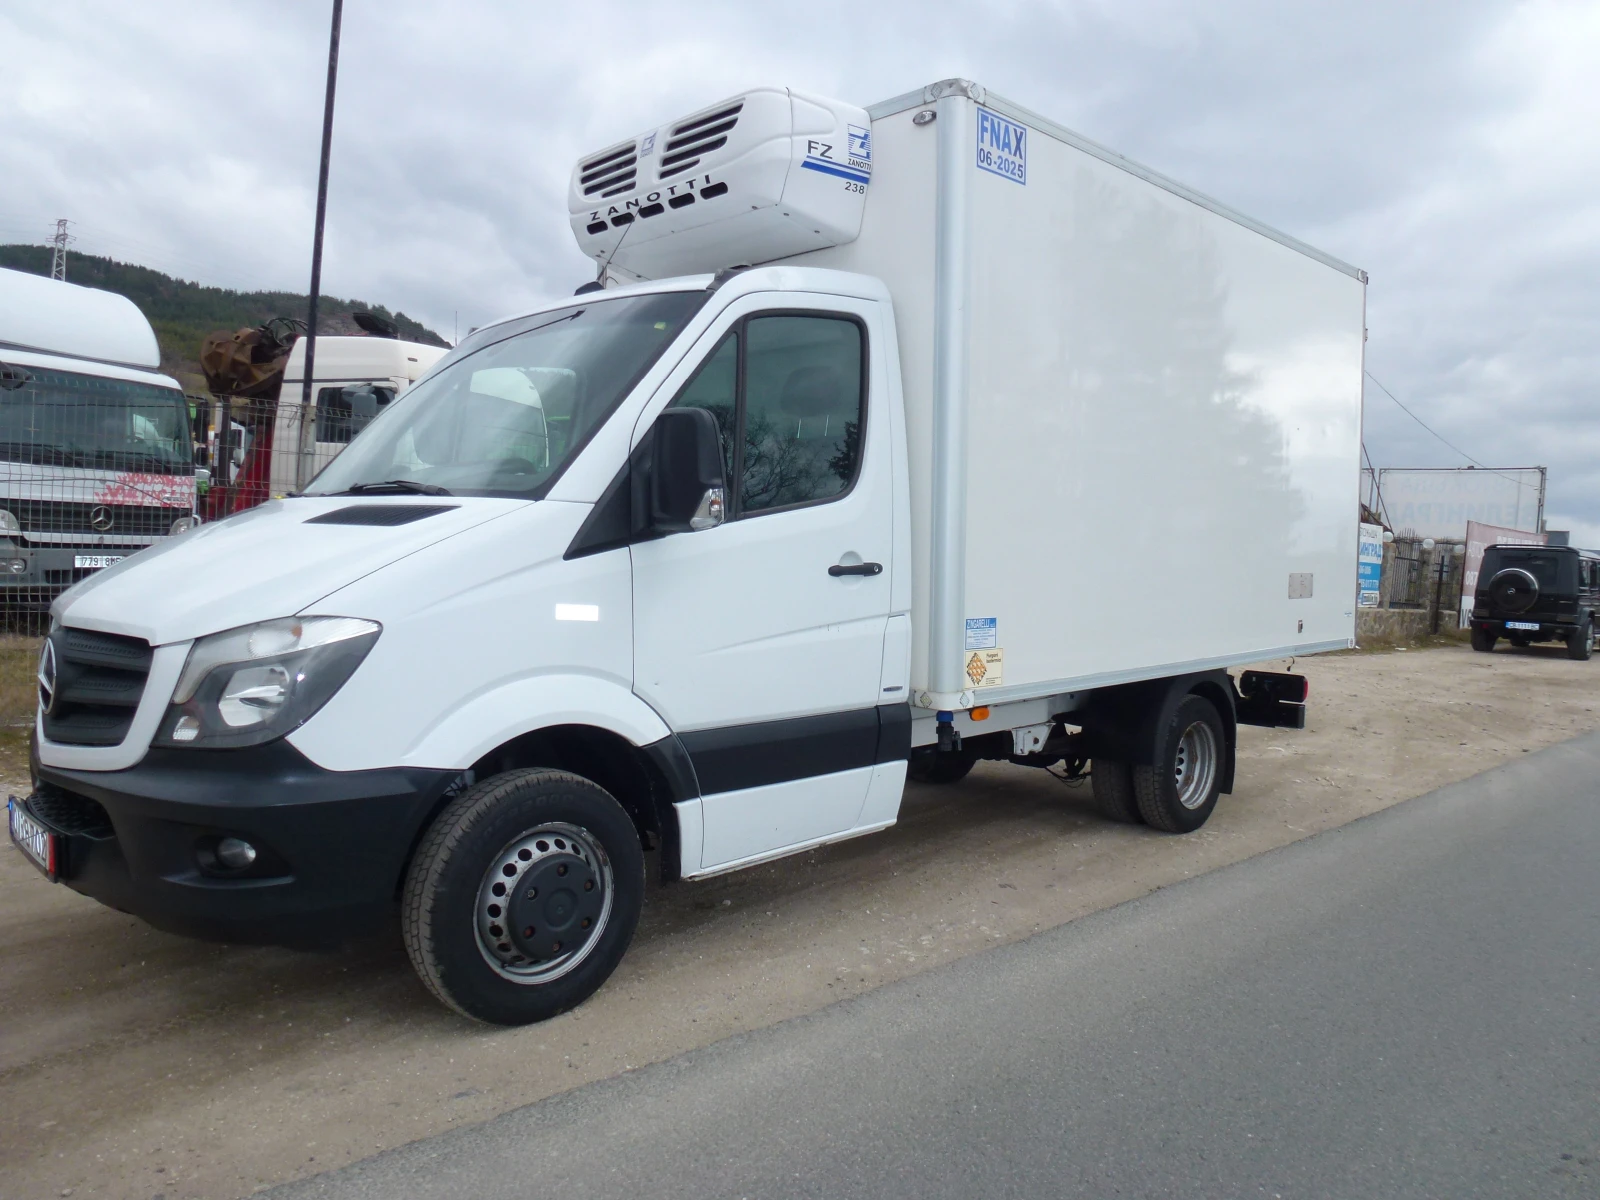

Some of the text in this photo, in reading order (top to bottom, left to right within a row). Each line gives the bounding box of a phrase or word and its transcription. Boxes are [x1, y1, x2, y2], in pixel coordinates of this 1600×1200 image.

[807, 140, 833, 160] FZ
[980, 113, 1024, 160] FNAX
[979, 147, 1024, 179] 06-2025
[589, 174, 711, 222] ZANOTTI
[844, 181, 865, 195] 238
